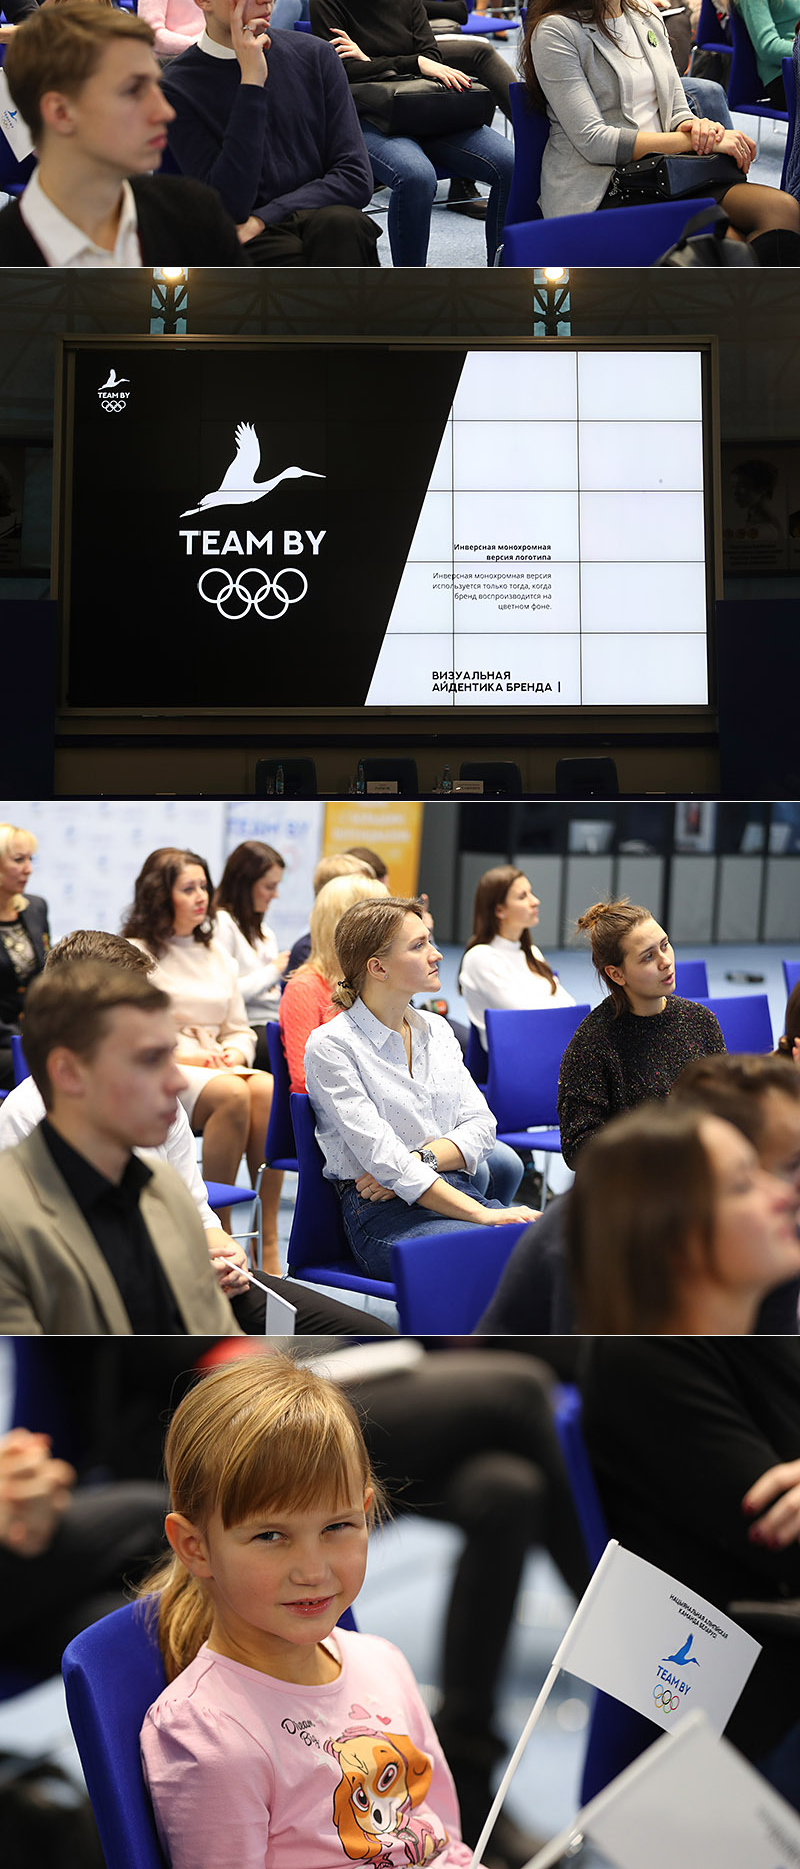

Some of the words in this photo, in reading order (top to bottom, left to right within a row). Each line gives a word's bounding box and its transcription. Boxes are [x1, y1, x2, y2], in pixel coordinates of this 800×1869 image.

[179, 531, 273, 556] TEAM
[283, 531, 327, 556] BY
[432, 572, 473, 580] Инверсная
[454, 592, 478, 601] бренд
[478, 593, 541, 601] воспроизводится
[530, 603, 552, 611] фоне.
[432, 671, 511, 680] ВИЗУАЛЬНАЯ
[432, 681, 504, 693] АЙДЕНТИКА
[506, 683, 553, 693] БРЕНДА
[656, 1665, 680, 1689] TEAM
[680, 1681, 692, 1695] BY
[281, 1718, 316, 1734] Dream
